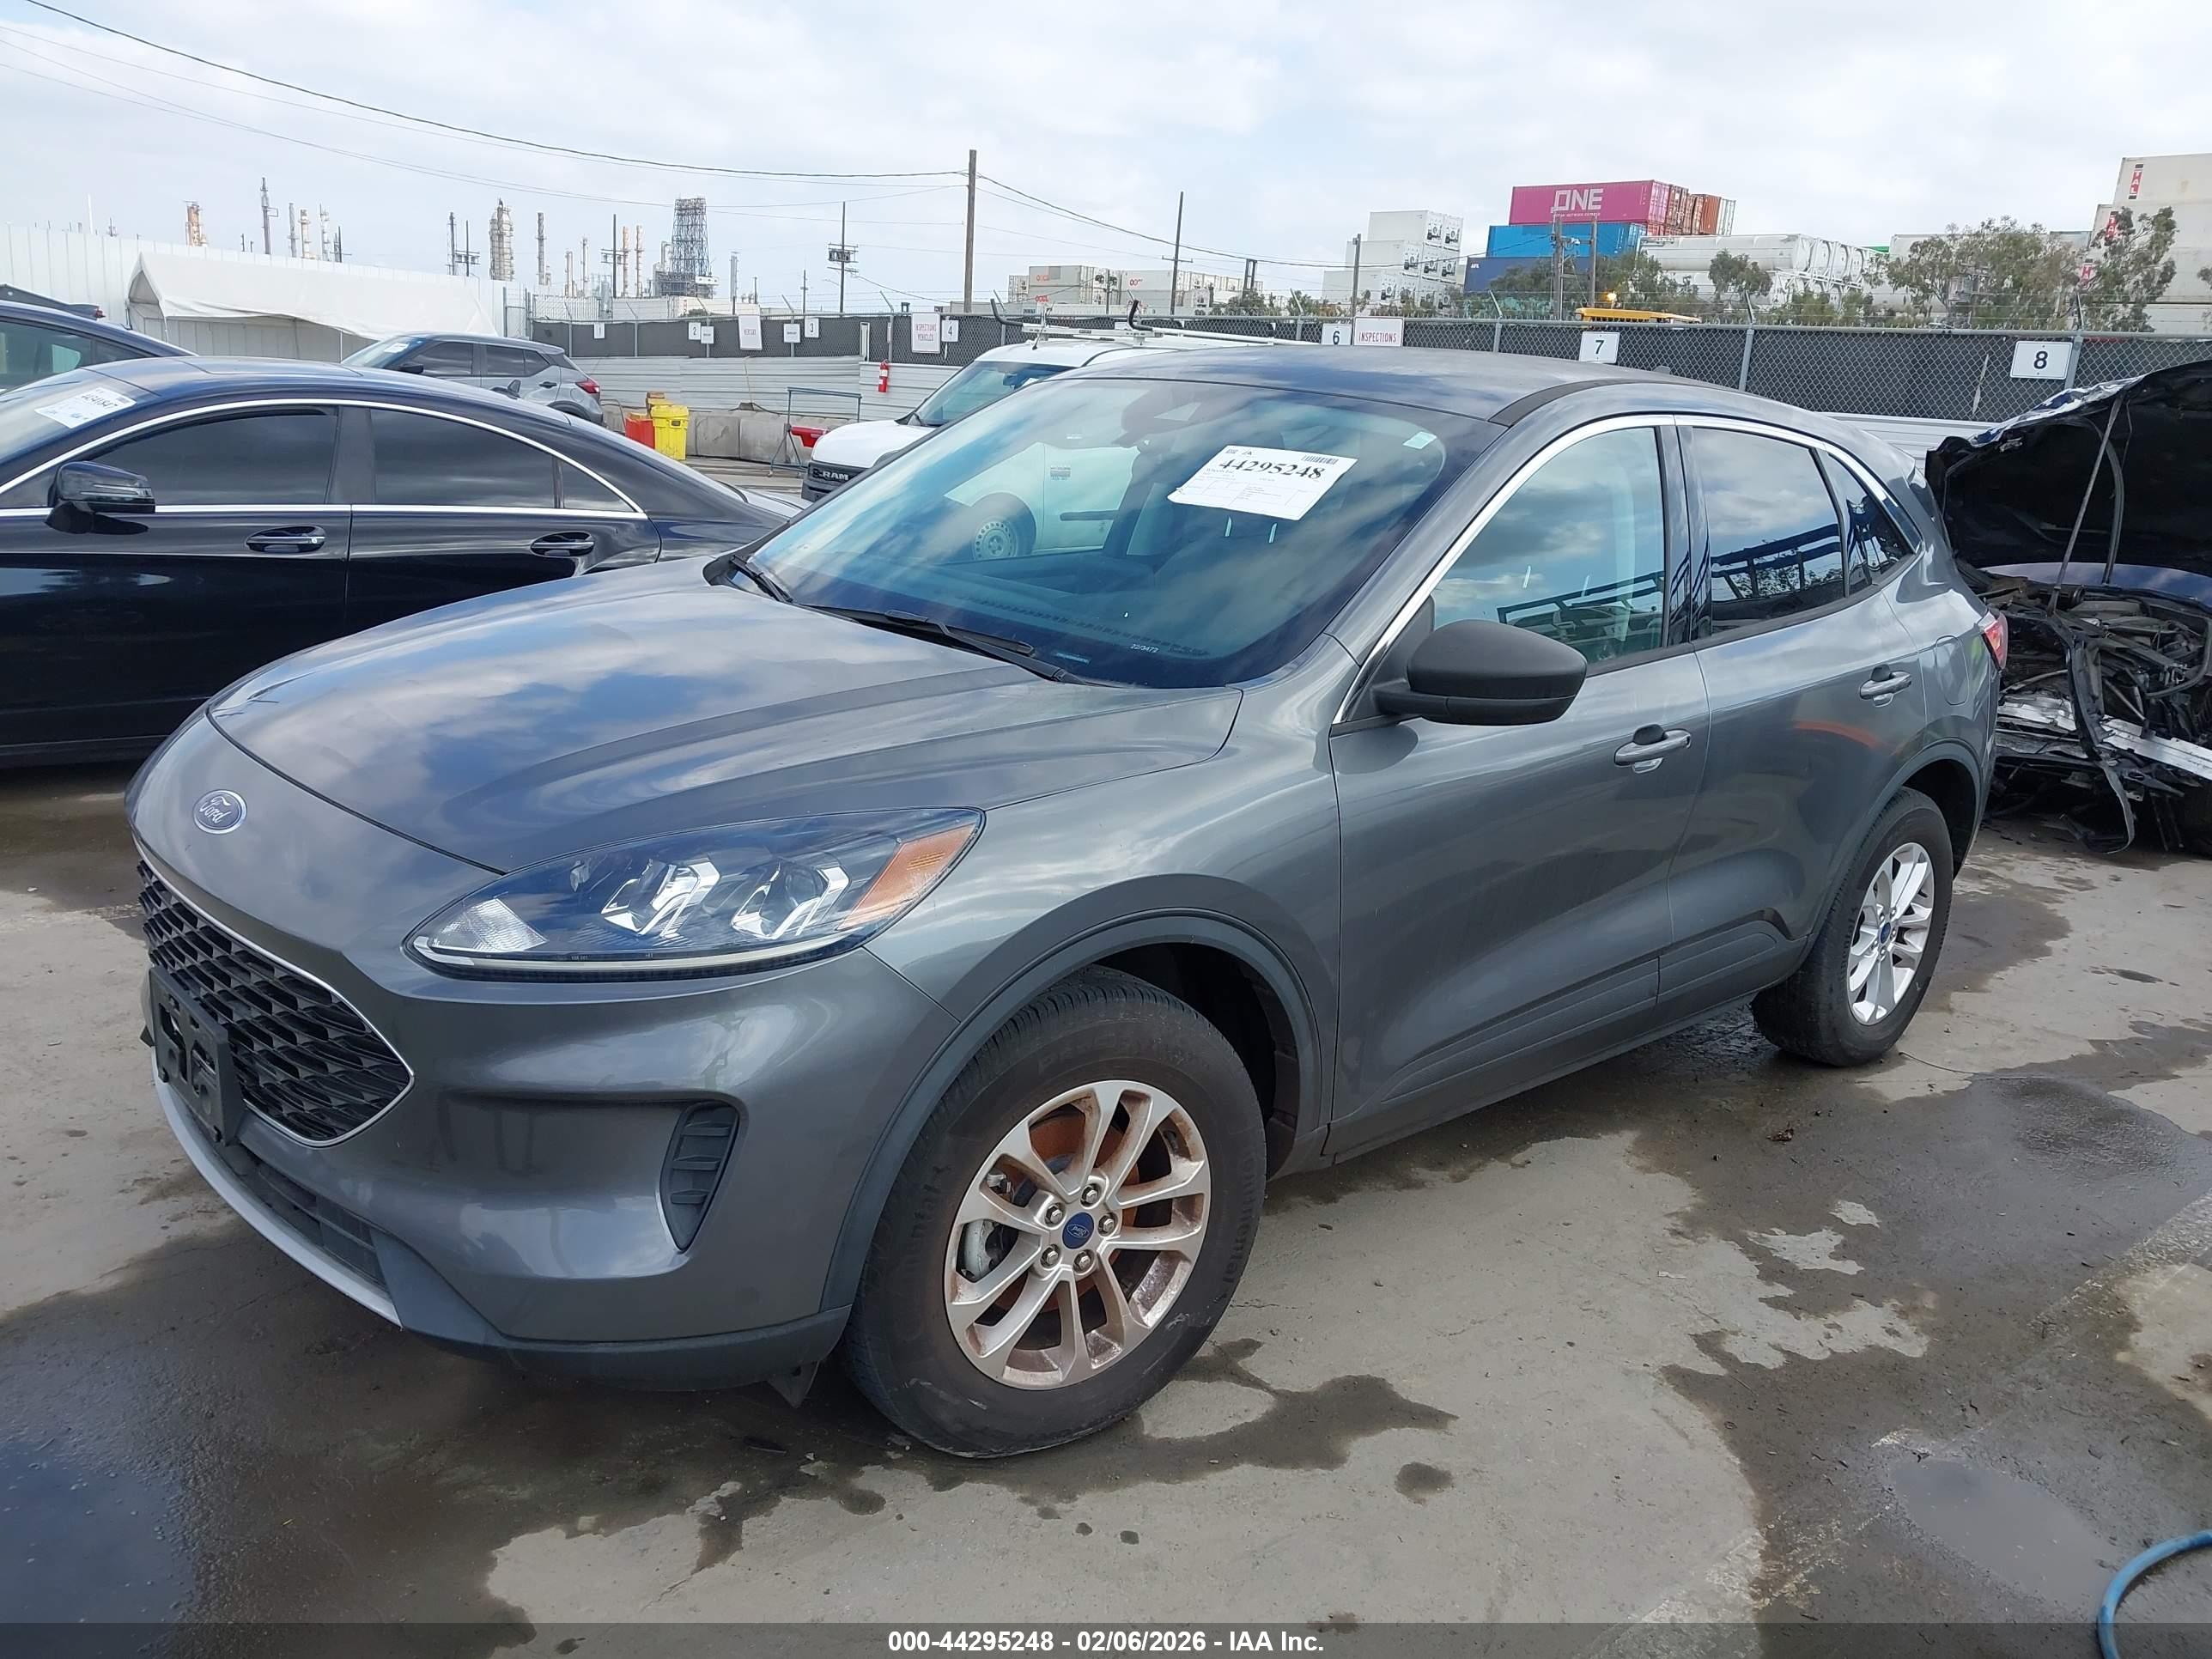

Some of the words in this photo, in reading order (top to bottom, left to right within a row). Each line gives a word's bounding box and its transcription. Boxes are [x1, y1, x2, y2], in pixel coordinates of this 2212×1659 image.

[2130, 170, 2142, 194] TAL
[1551, 188, 1604, 213] ONE
[692, 326, 696, 336] 2
[810, 323, 814, 332] 3
[947, 325, 953, 337] 4
[1333, 331, 1340, 345] 6
[1358, 331, 1397, 343] INSPECTIONS
[1595, 339, 1605, 355] 7
[2033, 350, 2048, 369] 8
[823, 471, 849, 481] RAM
[1219, 458, 1326, 481] 44295248
[199, 795, 233, 823] Ford
